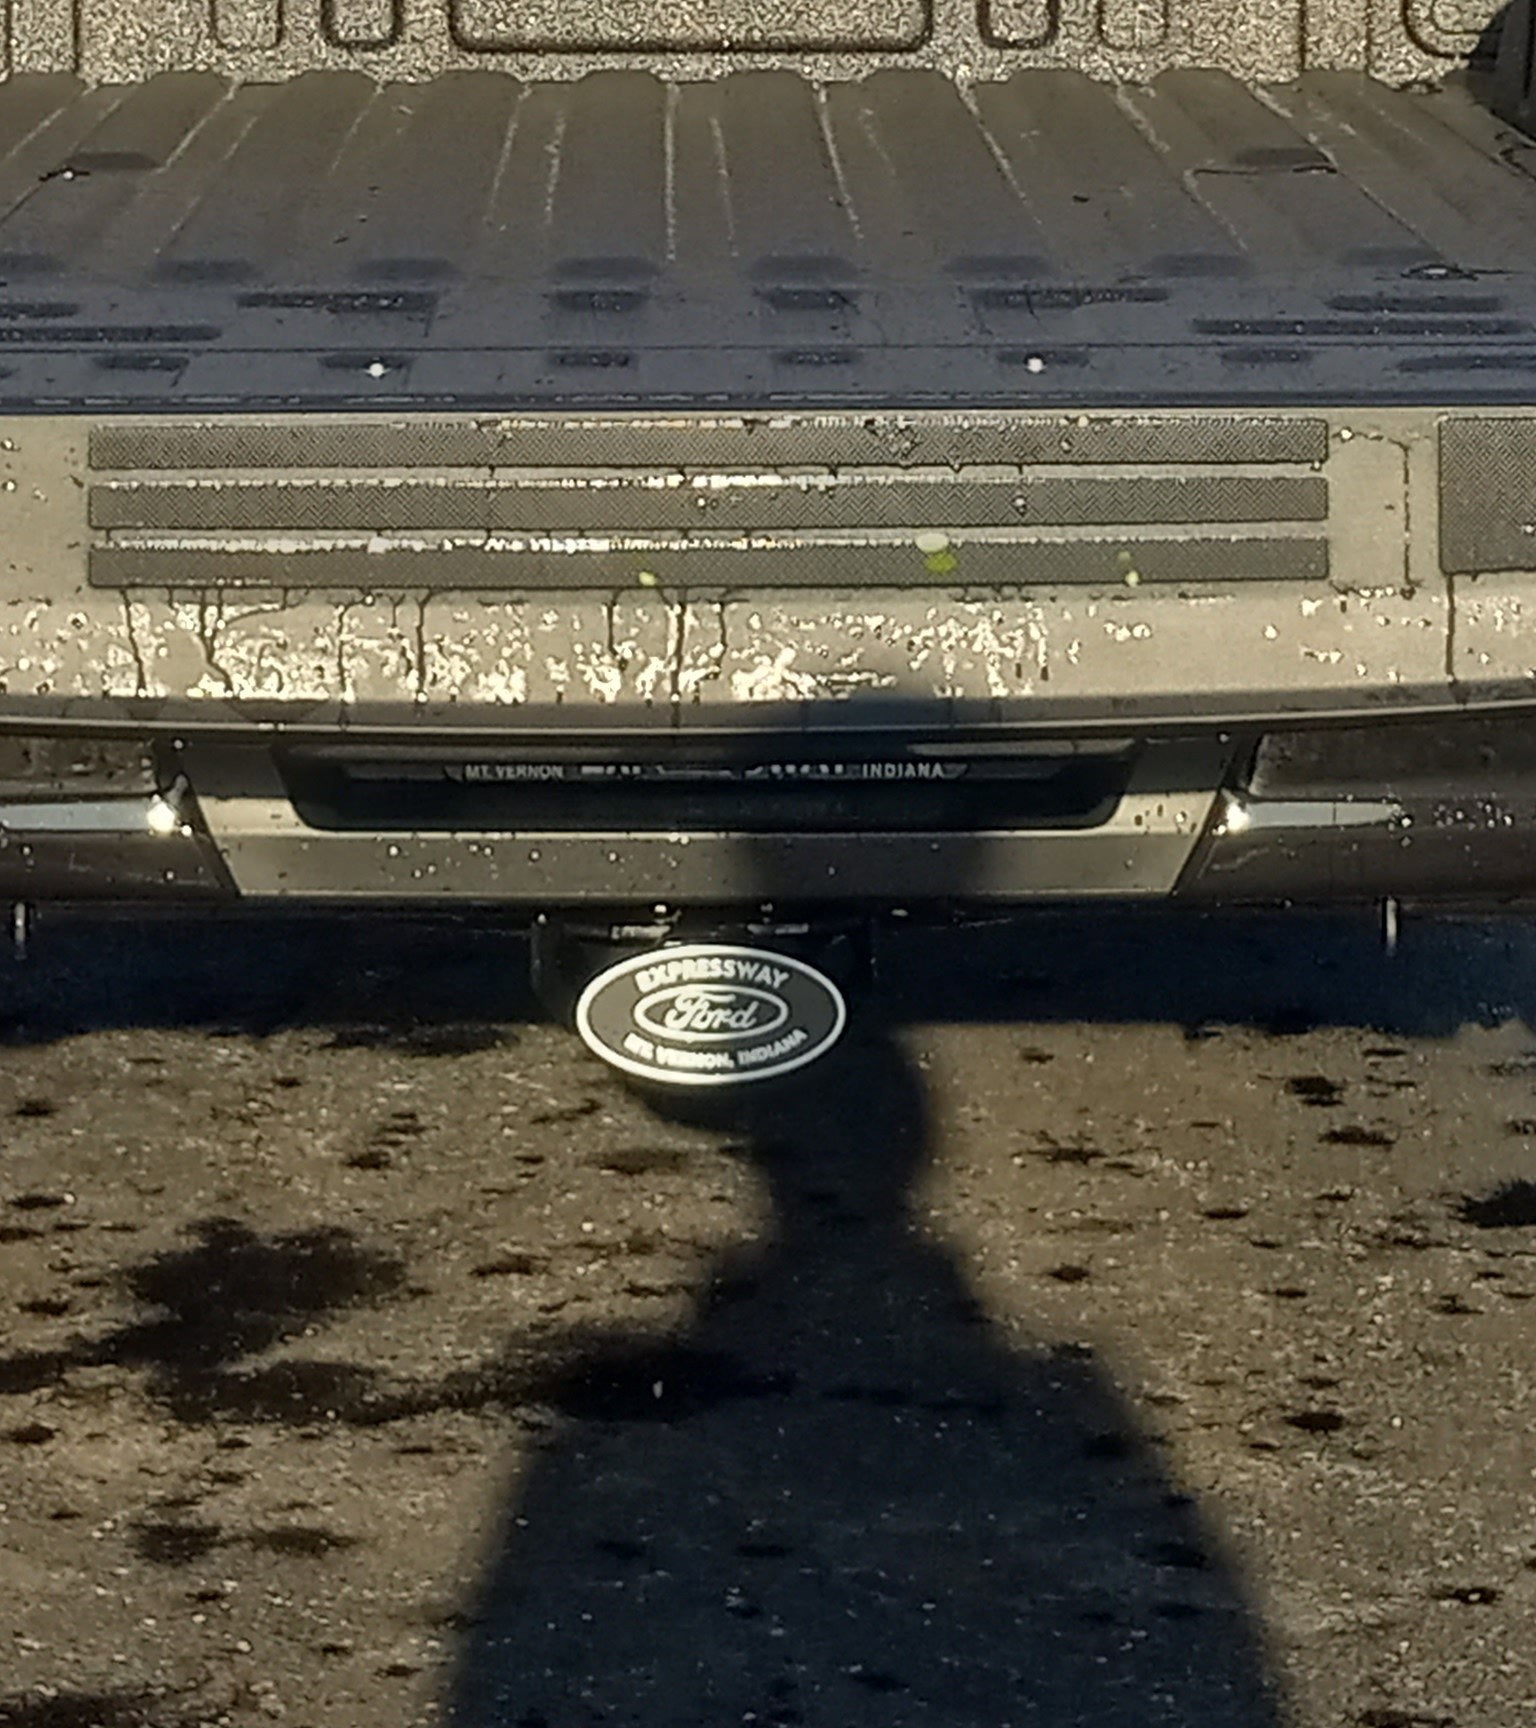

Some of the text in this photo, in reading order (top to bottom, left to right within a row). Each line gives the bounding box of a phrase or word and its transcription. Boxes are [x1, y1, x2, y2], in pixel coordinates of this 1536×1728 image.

[495, 763, 565, 780] VERNON
[862, 762, 945, 779] INDIANA
[635, 958, 789, 992] EXPRESSWAY
[665, 993, 760, 1029] Ford
[738, 1029, 808, 1065] INDIANA
